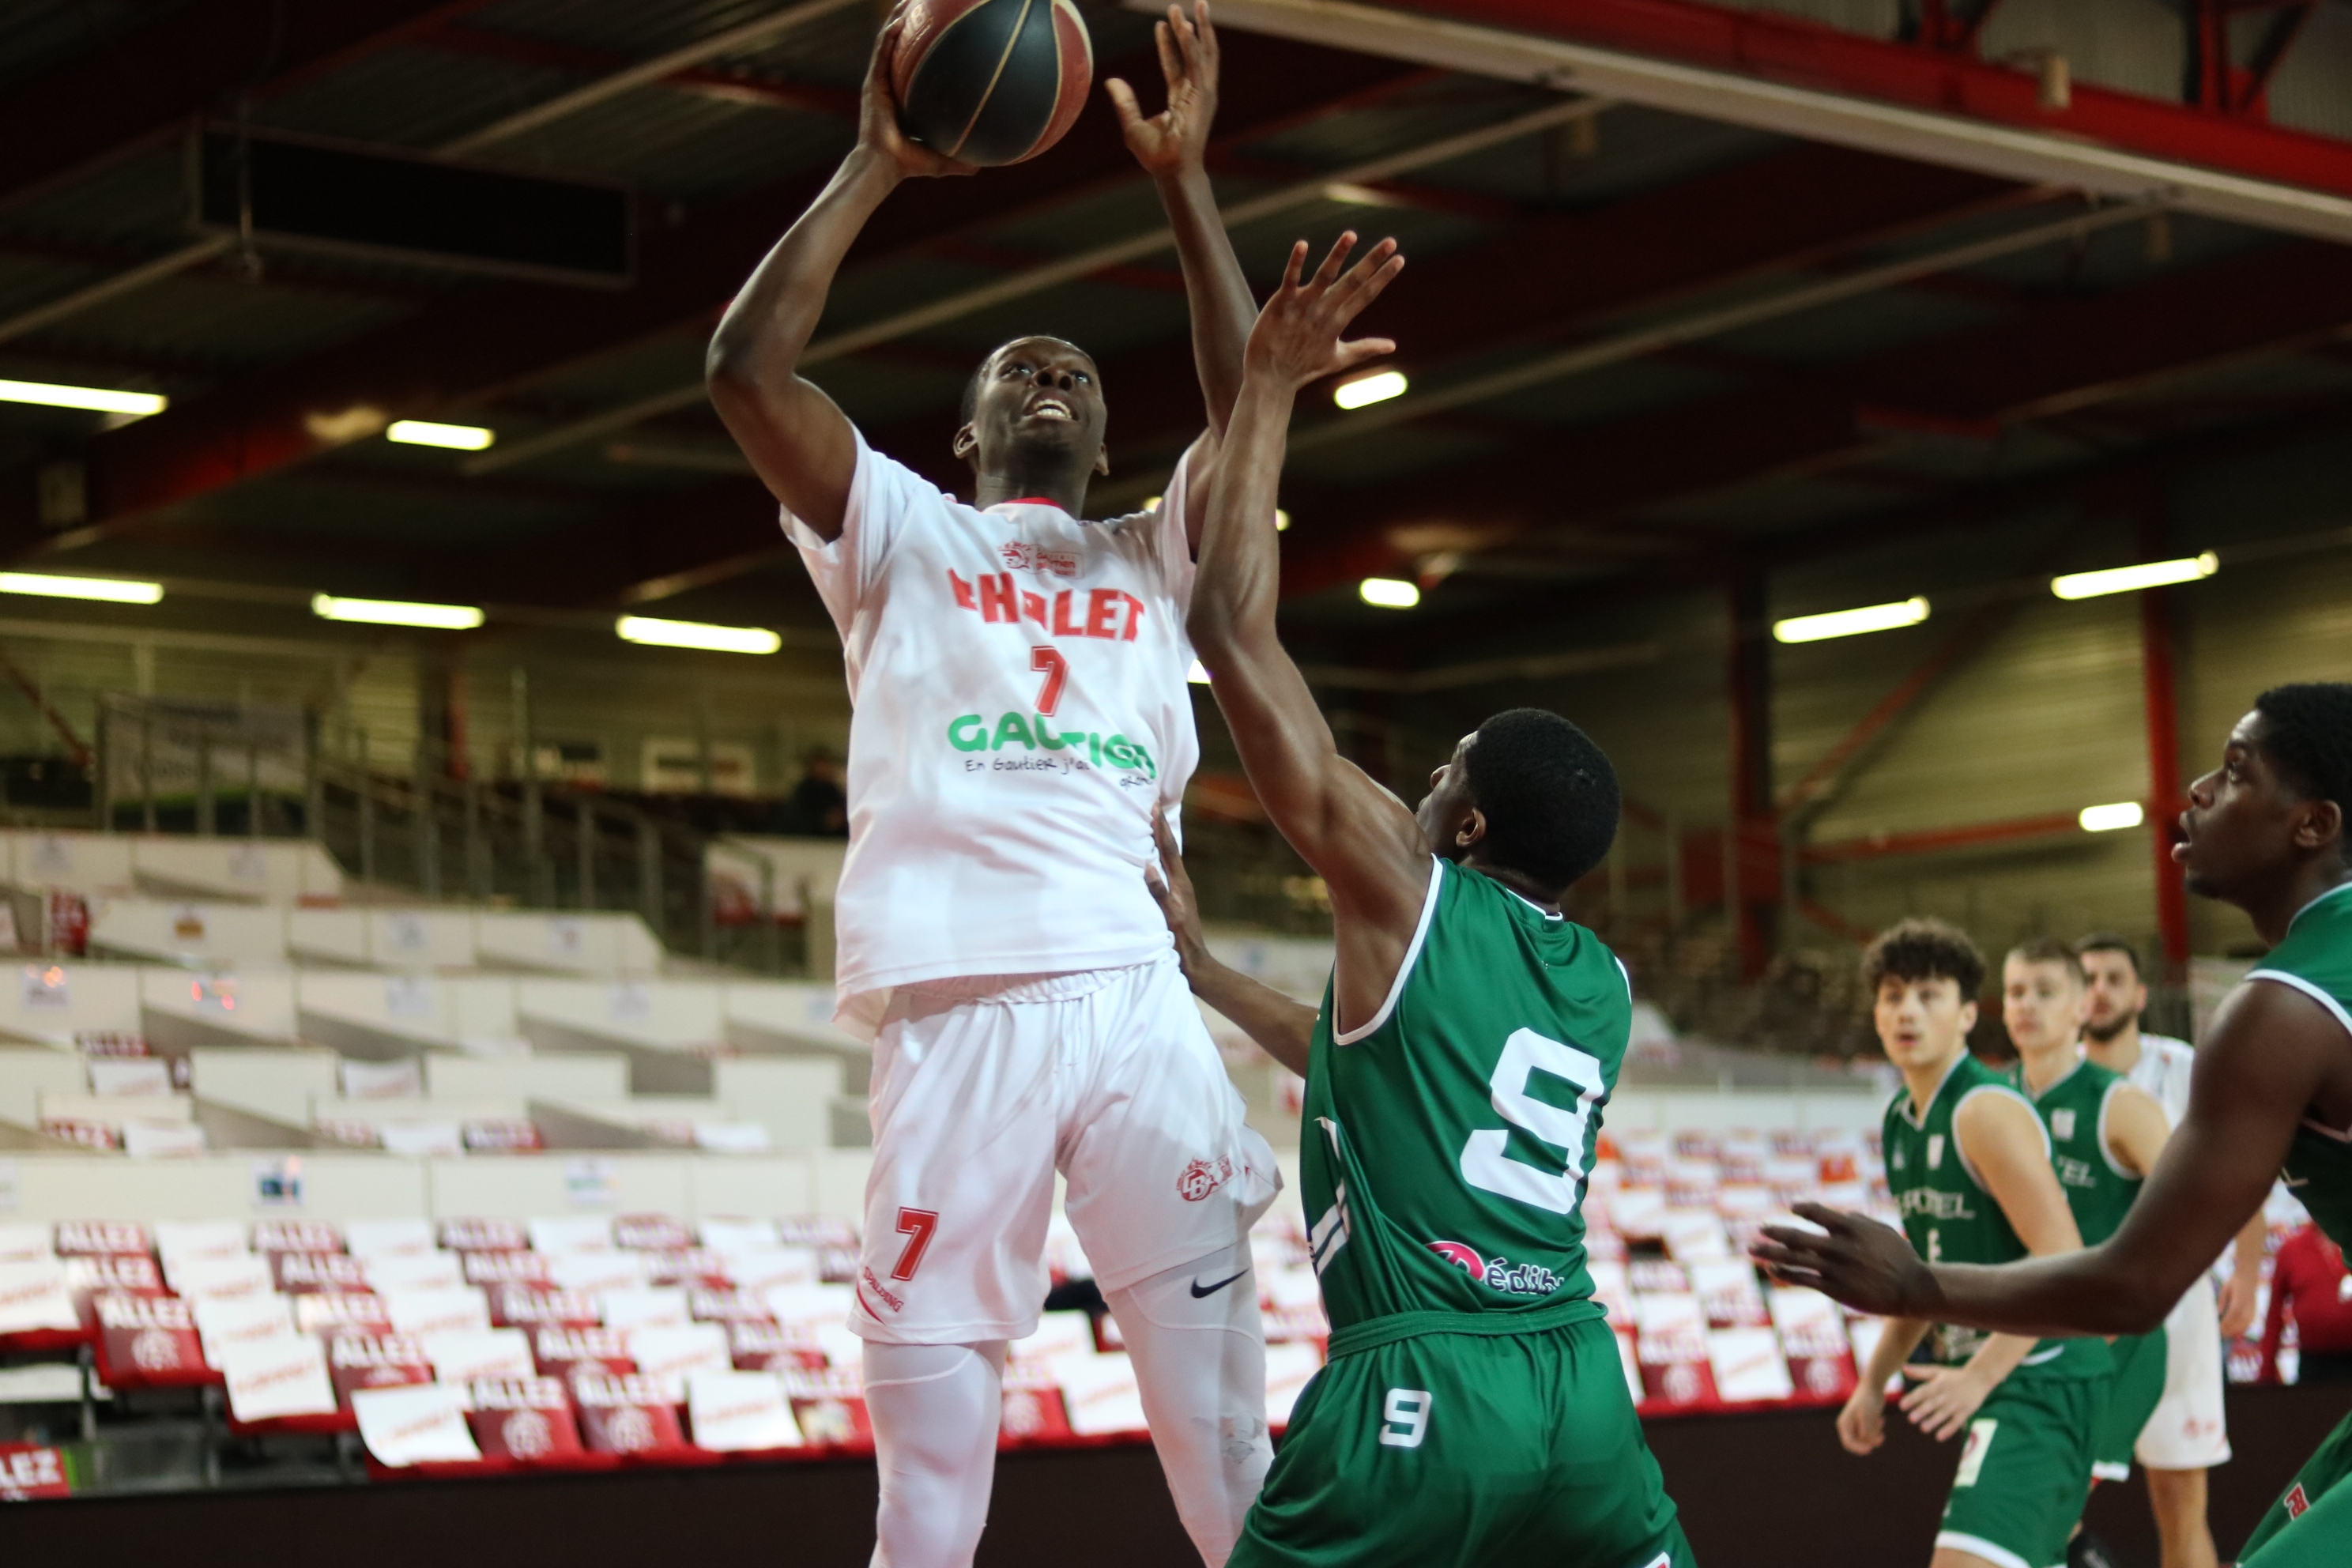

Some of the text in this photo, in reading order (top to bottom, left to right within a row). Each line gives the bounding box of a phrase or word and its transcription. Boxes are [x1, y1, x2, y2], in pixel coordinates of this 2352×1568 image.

[1031, 646, 1069, 717] 7
[1459, 1027, 1604, 1215] 9
[890, 1207, 939, 1281] 7
[864, 1266, 904, 1313] SPALDING
[1379, 1388, 1432, 1447] 9
